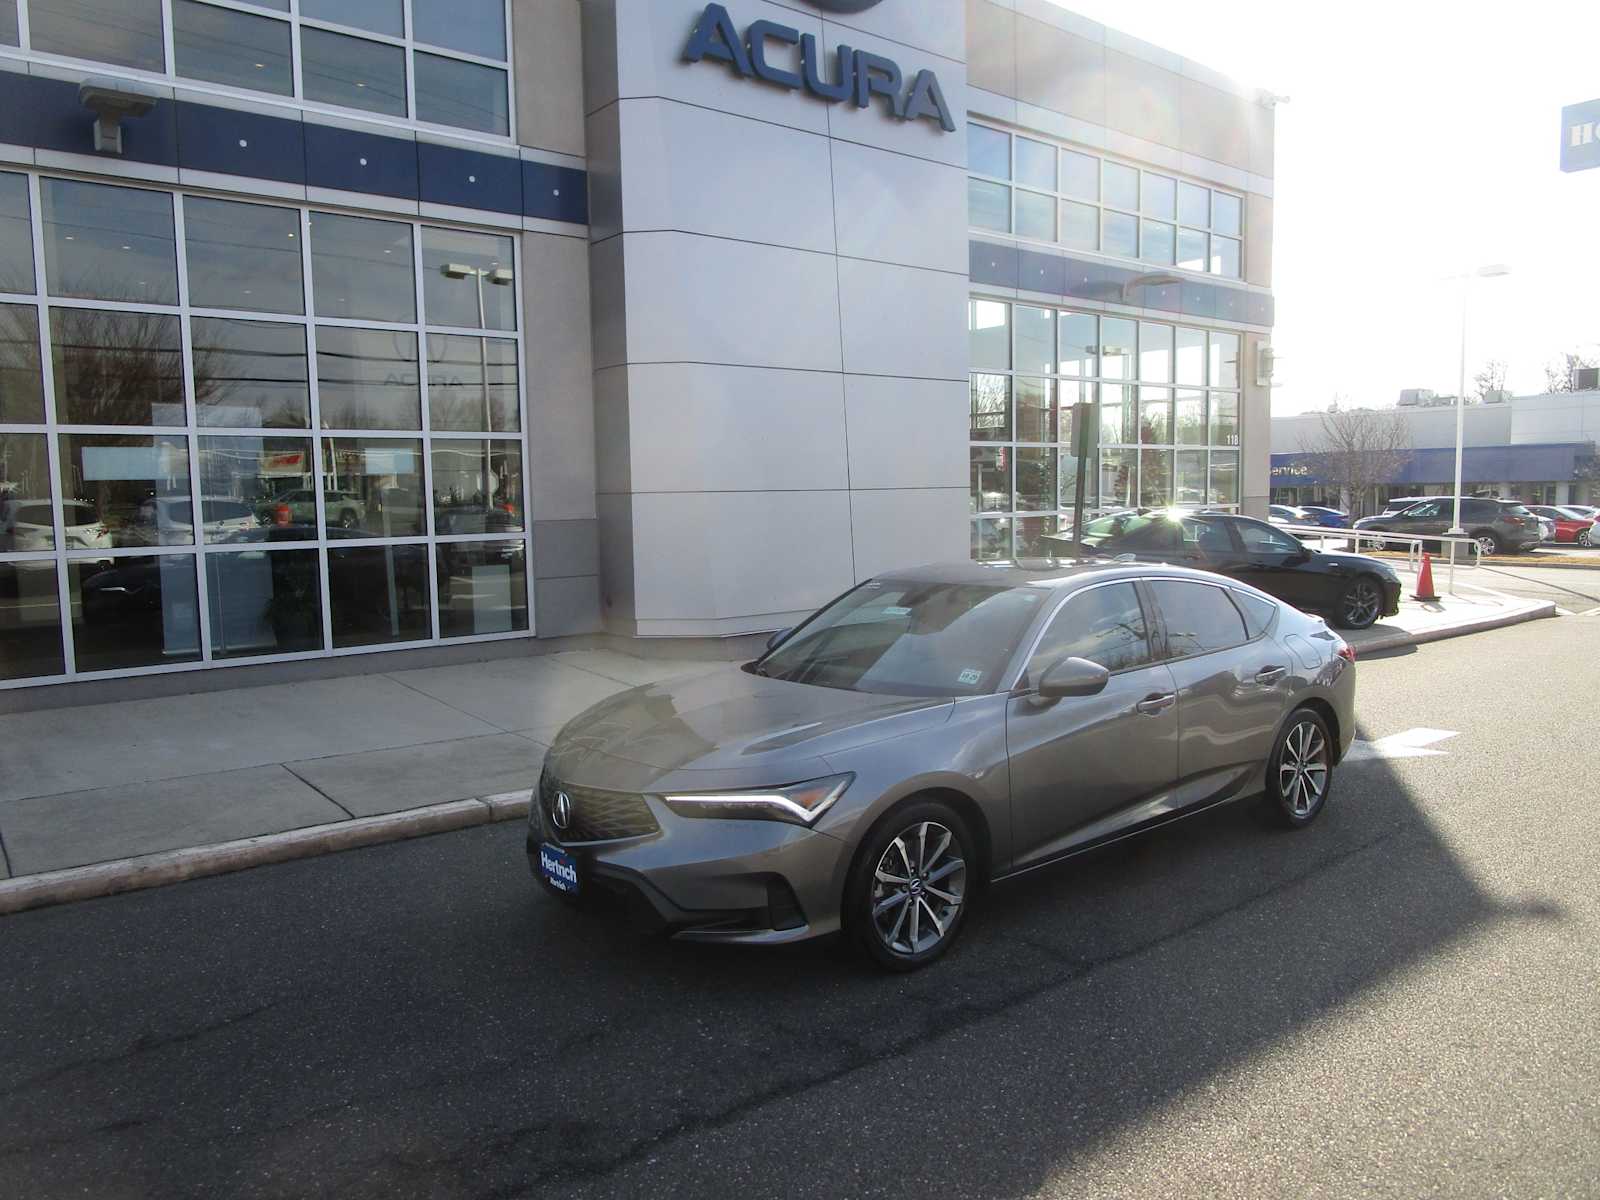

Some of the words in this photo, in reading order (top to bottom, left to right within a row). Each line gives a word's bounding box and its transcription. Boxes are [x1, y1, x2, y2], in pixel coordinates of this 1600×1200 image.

[685, 2, 955, 132] ACURA
[1226, 434, 1239, 445] 118
[1271, 463, 1308, 476] ervice
